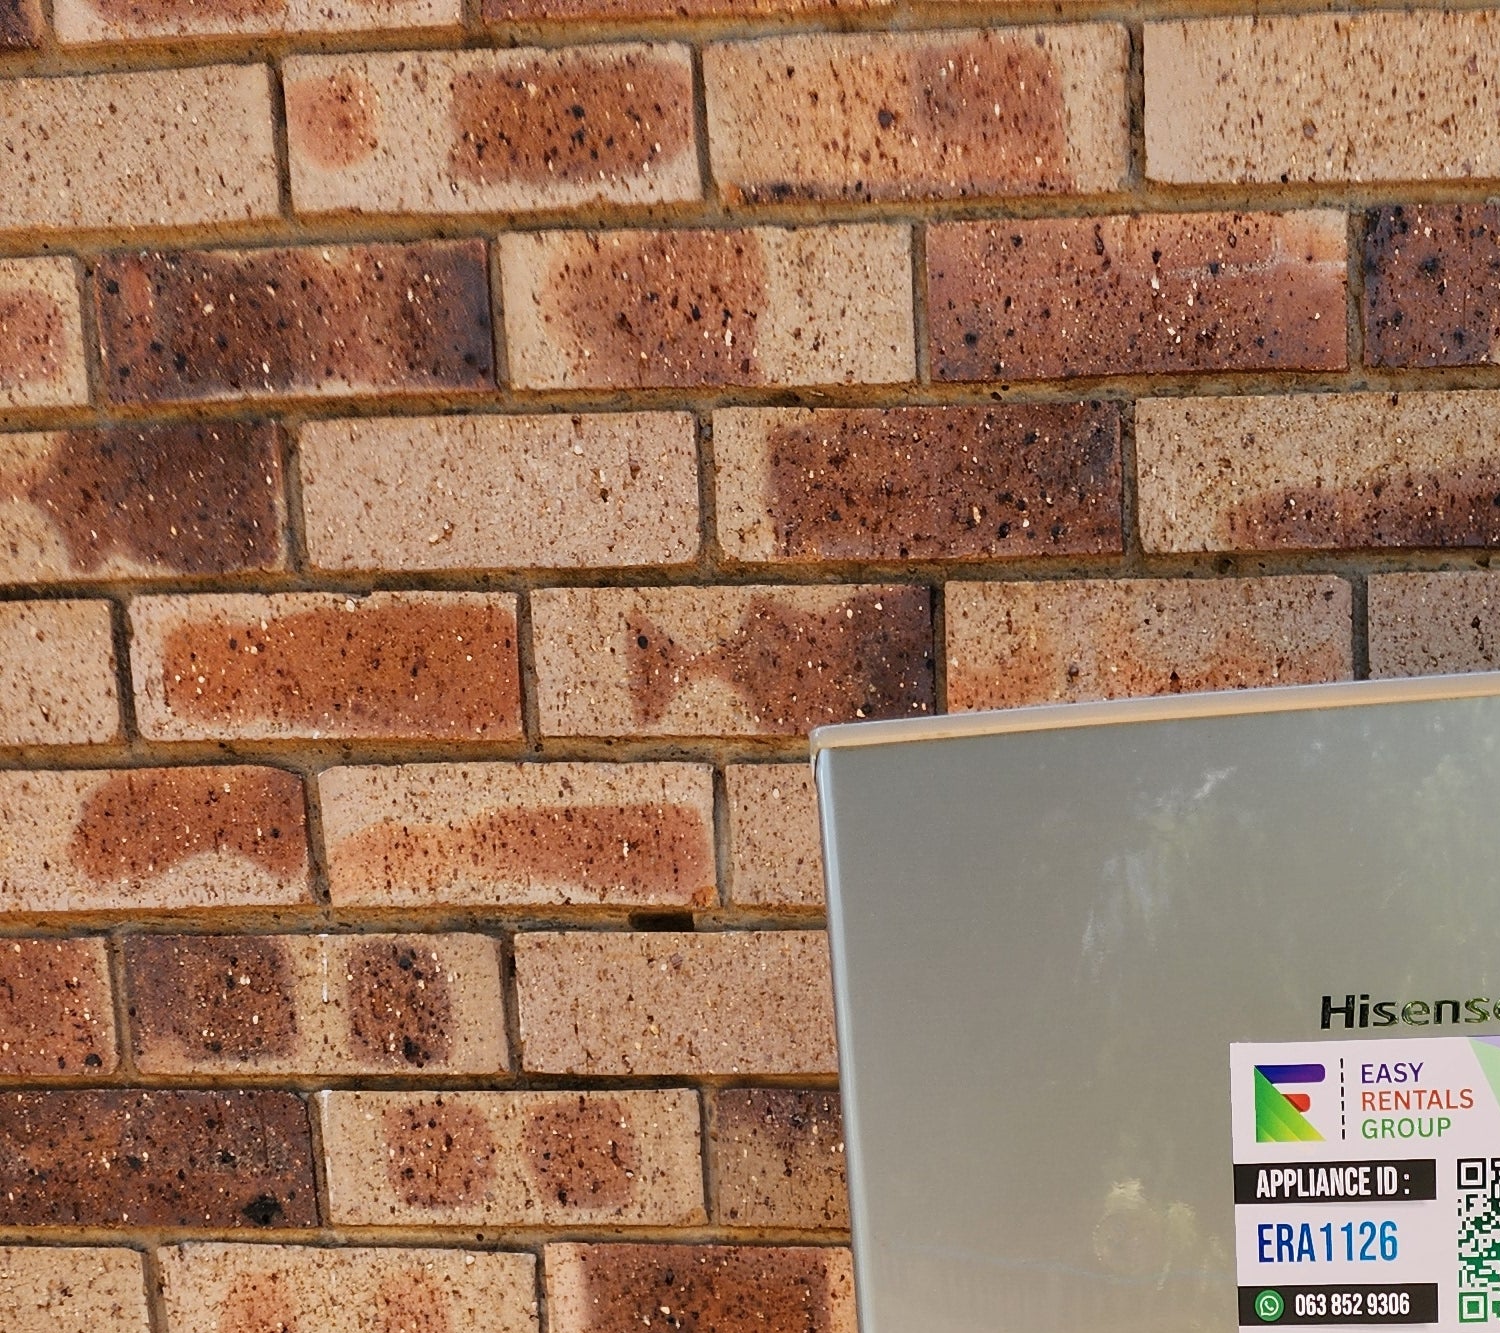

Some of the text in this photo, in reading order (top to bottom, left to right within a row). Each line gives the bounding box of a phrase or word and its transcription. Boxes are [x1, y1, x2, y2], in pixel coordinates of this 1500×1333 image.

[1361, 1061, 1424, 1084] EASY
[1361, 1088, 1475, 1111] RENTALS
[1361, 1117, 1452, 1140] GROUP
[1255, 1167, 1371, 1198] APPLIANCE
[1376, 1167, 1399, 1196] ID
[1257, 1220, 1398, 1263] ERA1126
[1294, 1292, 1410, 1317] 063 852 9306
